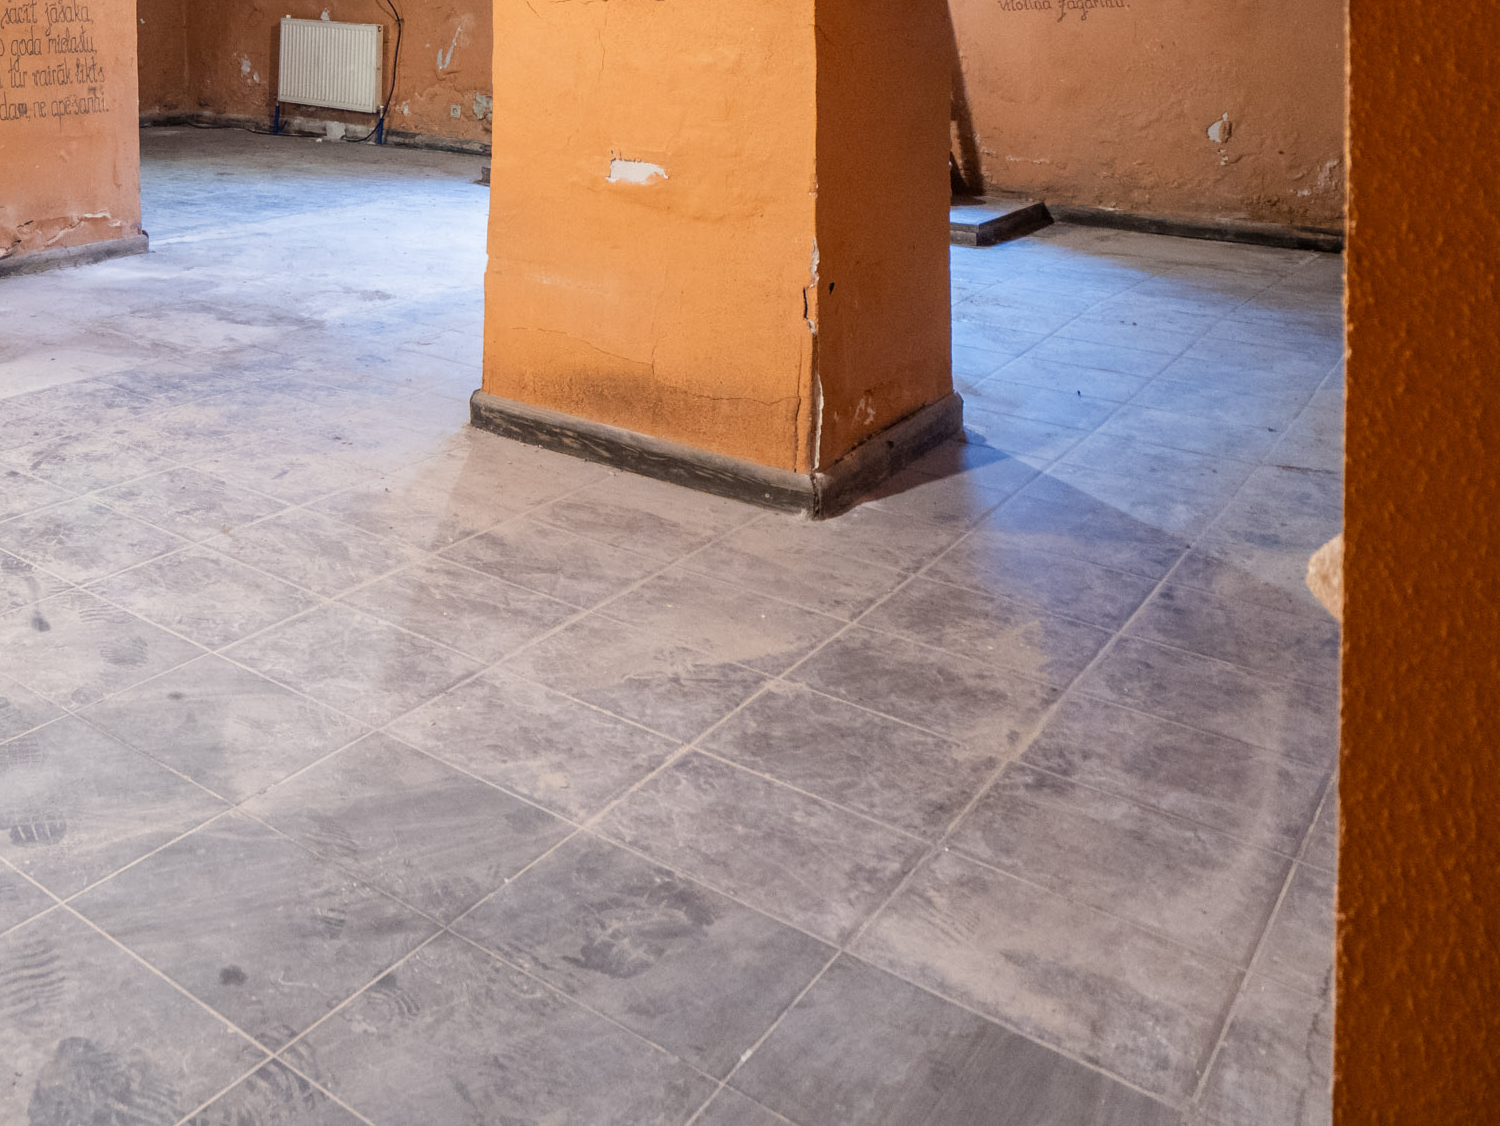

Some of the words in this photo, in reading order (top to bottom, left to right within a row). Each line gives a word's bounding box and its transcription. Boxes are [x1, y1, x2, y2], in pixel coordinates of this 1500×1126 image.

[10, 26, 43, 71] goda
[8, 56, 28, 89] tur
[33, 99, 47, 118] ne
